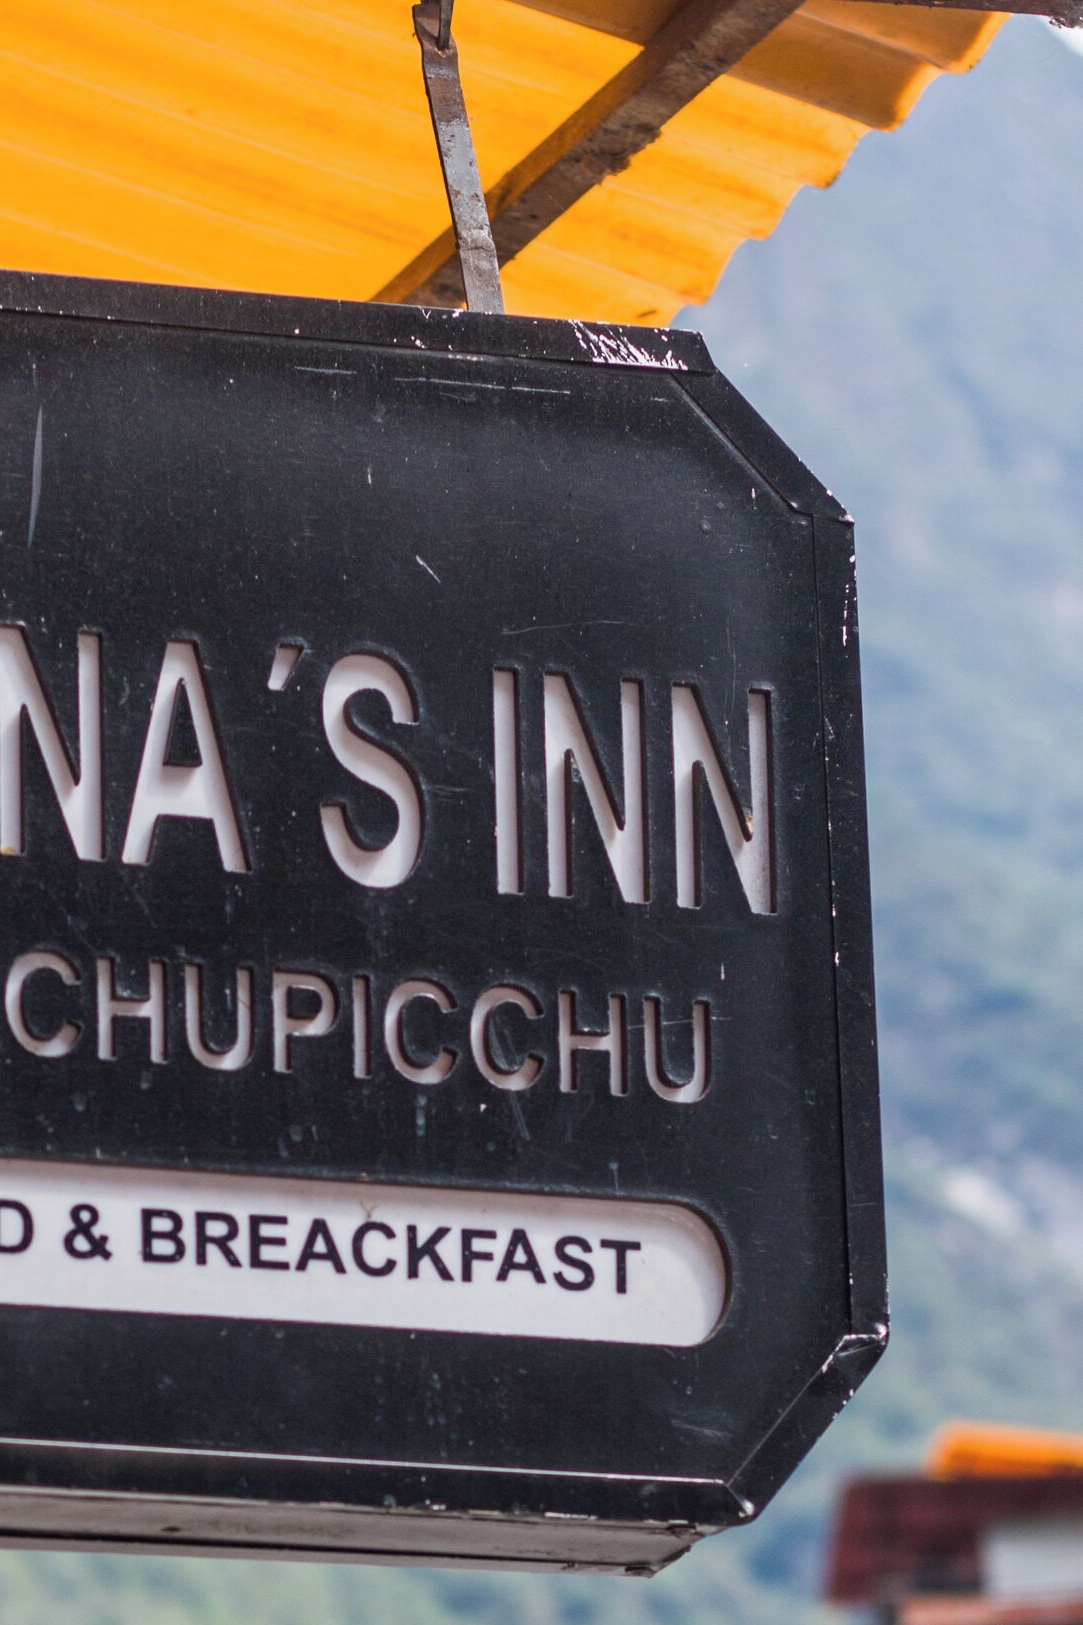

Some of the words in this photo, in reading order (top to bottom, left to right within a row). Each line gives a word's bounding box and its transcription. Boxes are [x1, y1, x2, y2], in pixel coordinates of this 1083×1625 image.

[492, 667, 778, 916] INN
[62, 1202, 113, 1261] &
[139, 1208, 642, 1296] BREACKFAST
